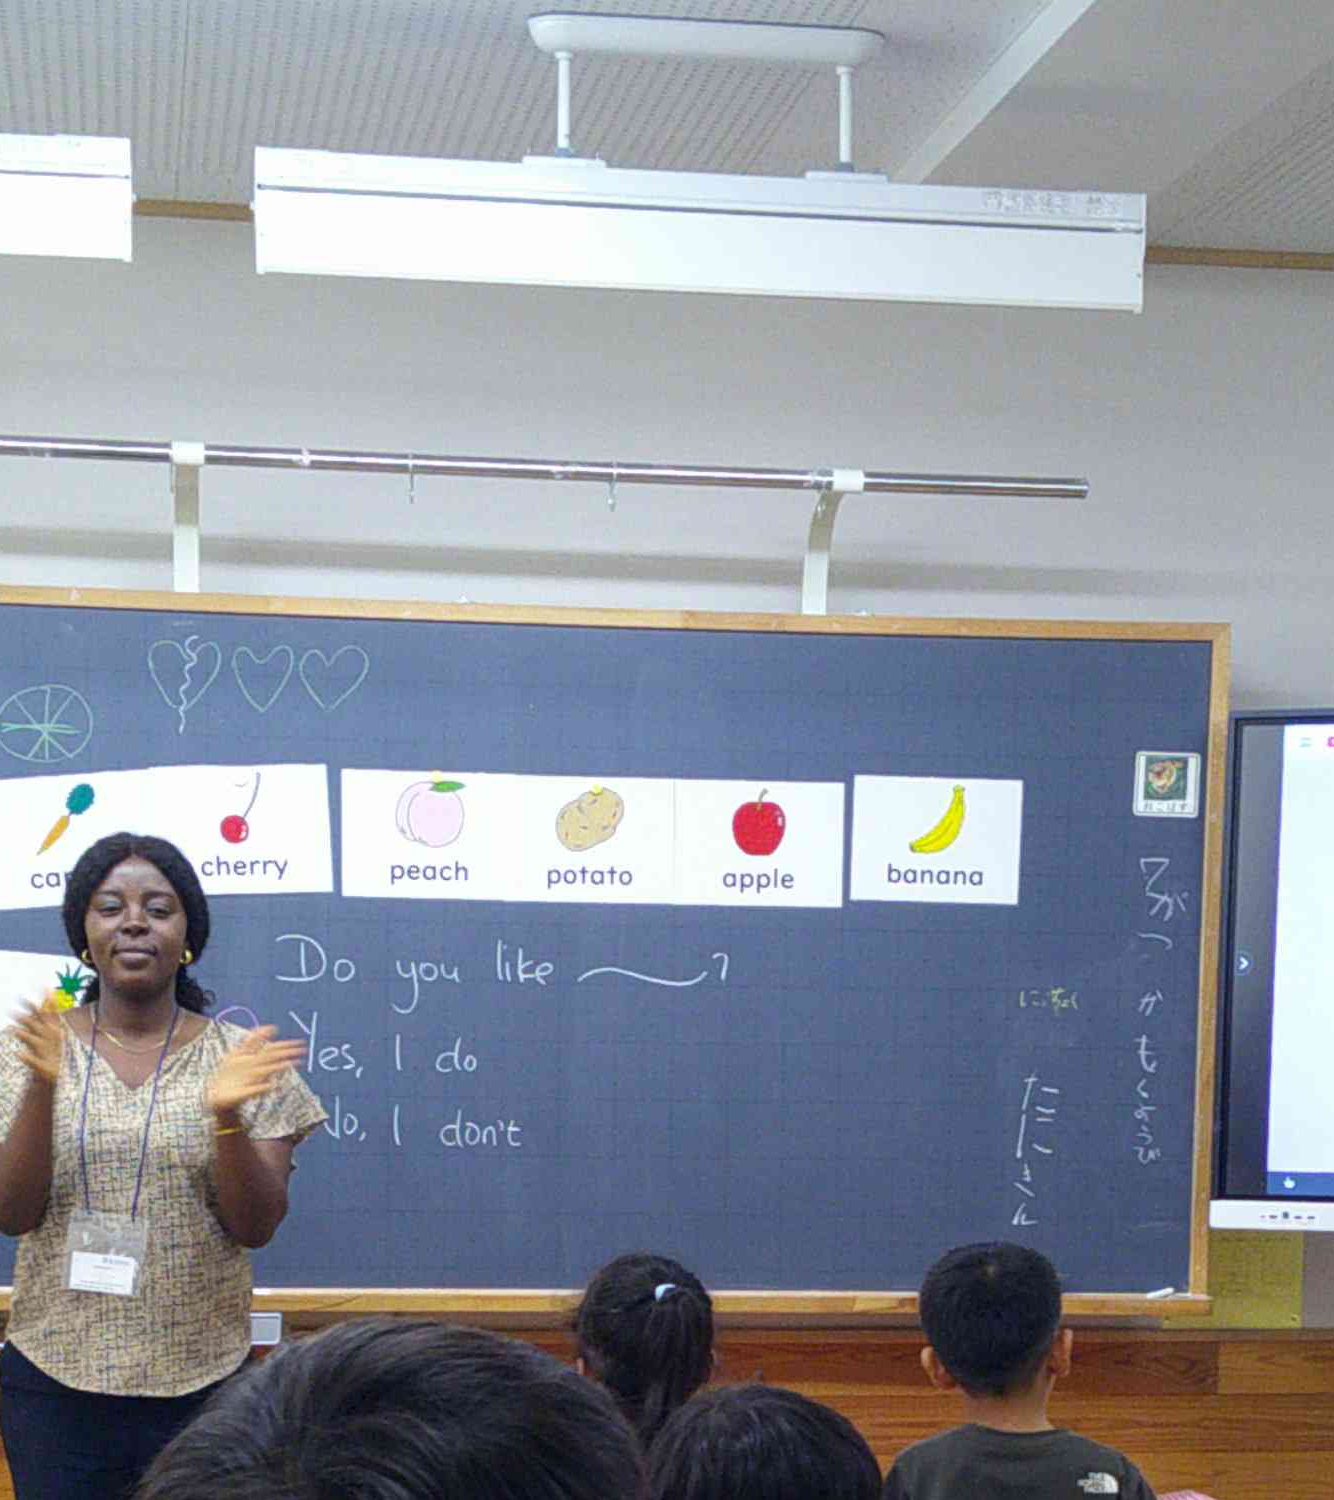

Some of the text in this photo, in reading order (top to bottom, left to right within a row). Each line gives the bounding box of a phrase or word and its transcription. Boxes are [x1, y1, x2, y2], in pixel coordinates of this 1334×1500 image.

[200, 855, 289, 881] cherry
[389, 860, 470, 887] peach
[546, 865, 634, 889] potato
[722, 868, 795, 894] apple
[886, 863, 985, 888] banana
[275, 934, 356, 983] Do
[391, 958, 461, 1015] you
[495, 939, 555, 986] like
[289, 1010, 364, 1078] Yes,
[434, 1036, 478, 1074] do
[438, 1109, 523, 1149] don't
